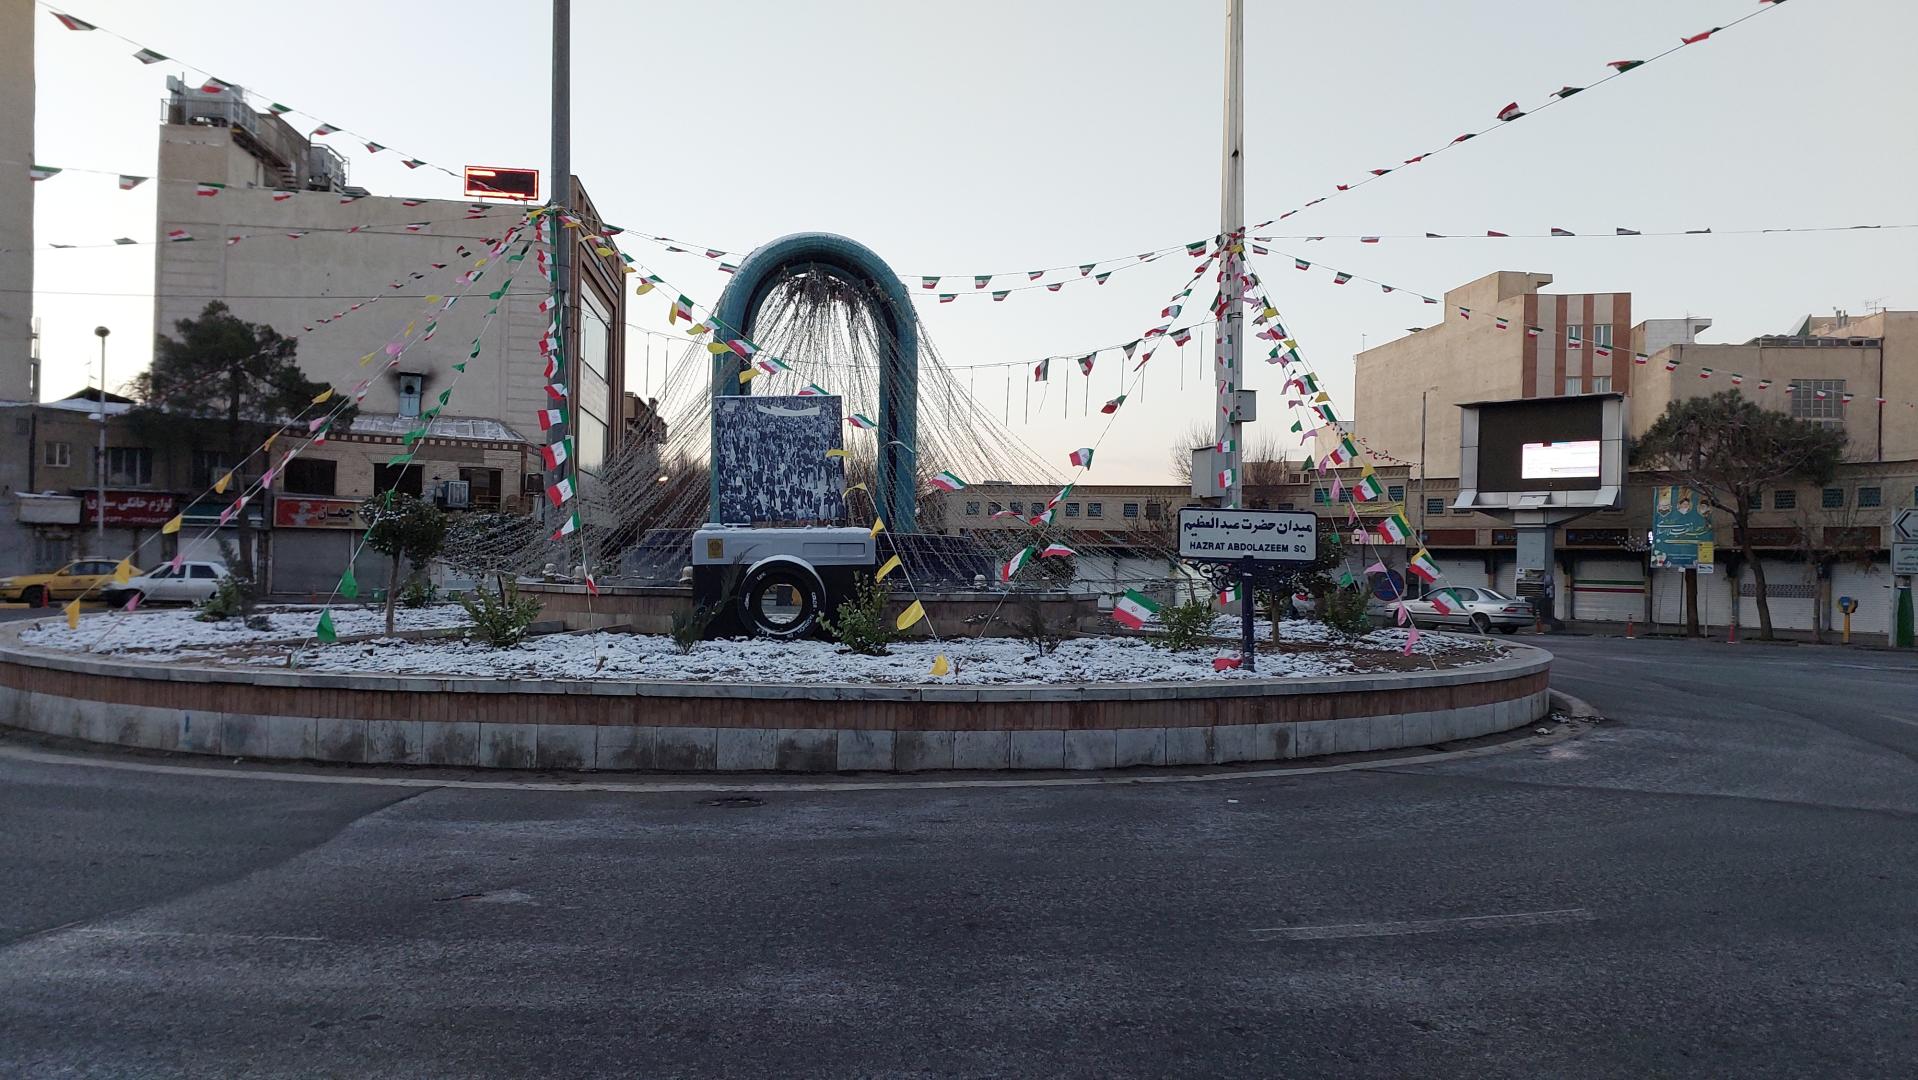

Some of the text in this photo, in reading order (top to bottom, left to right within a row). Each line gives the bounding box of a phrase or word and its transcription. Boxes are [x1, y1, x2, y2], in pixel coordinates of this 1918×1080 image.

[1242, 517, 1275, 534] حضرت
[1277, 520, 1313, 538] میدان
[1189, 541, 1307, 553] HAZRAT ABDOLAZEEM SQ
